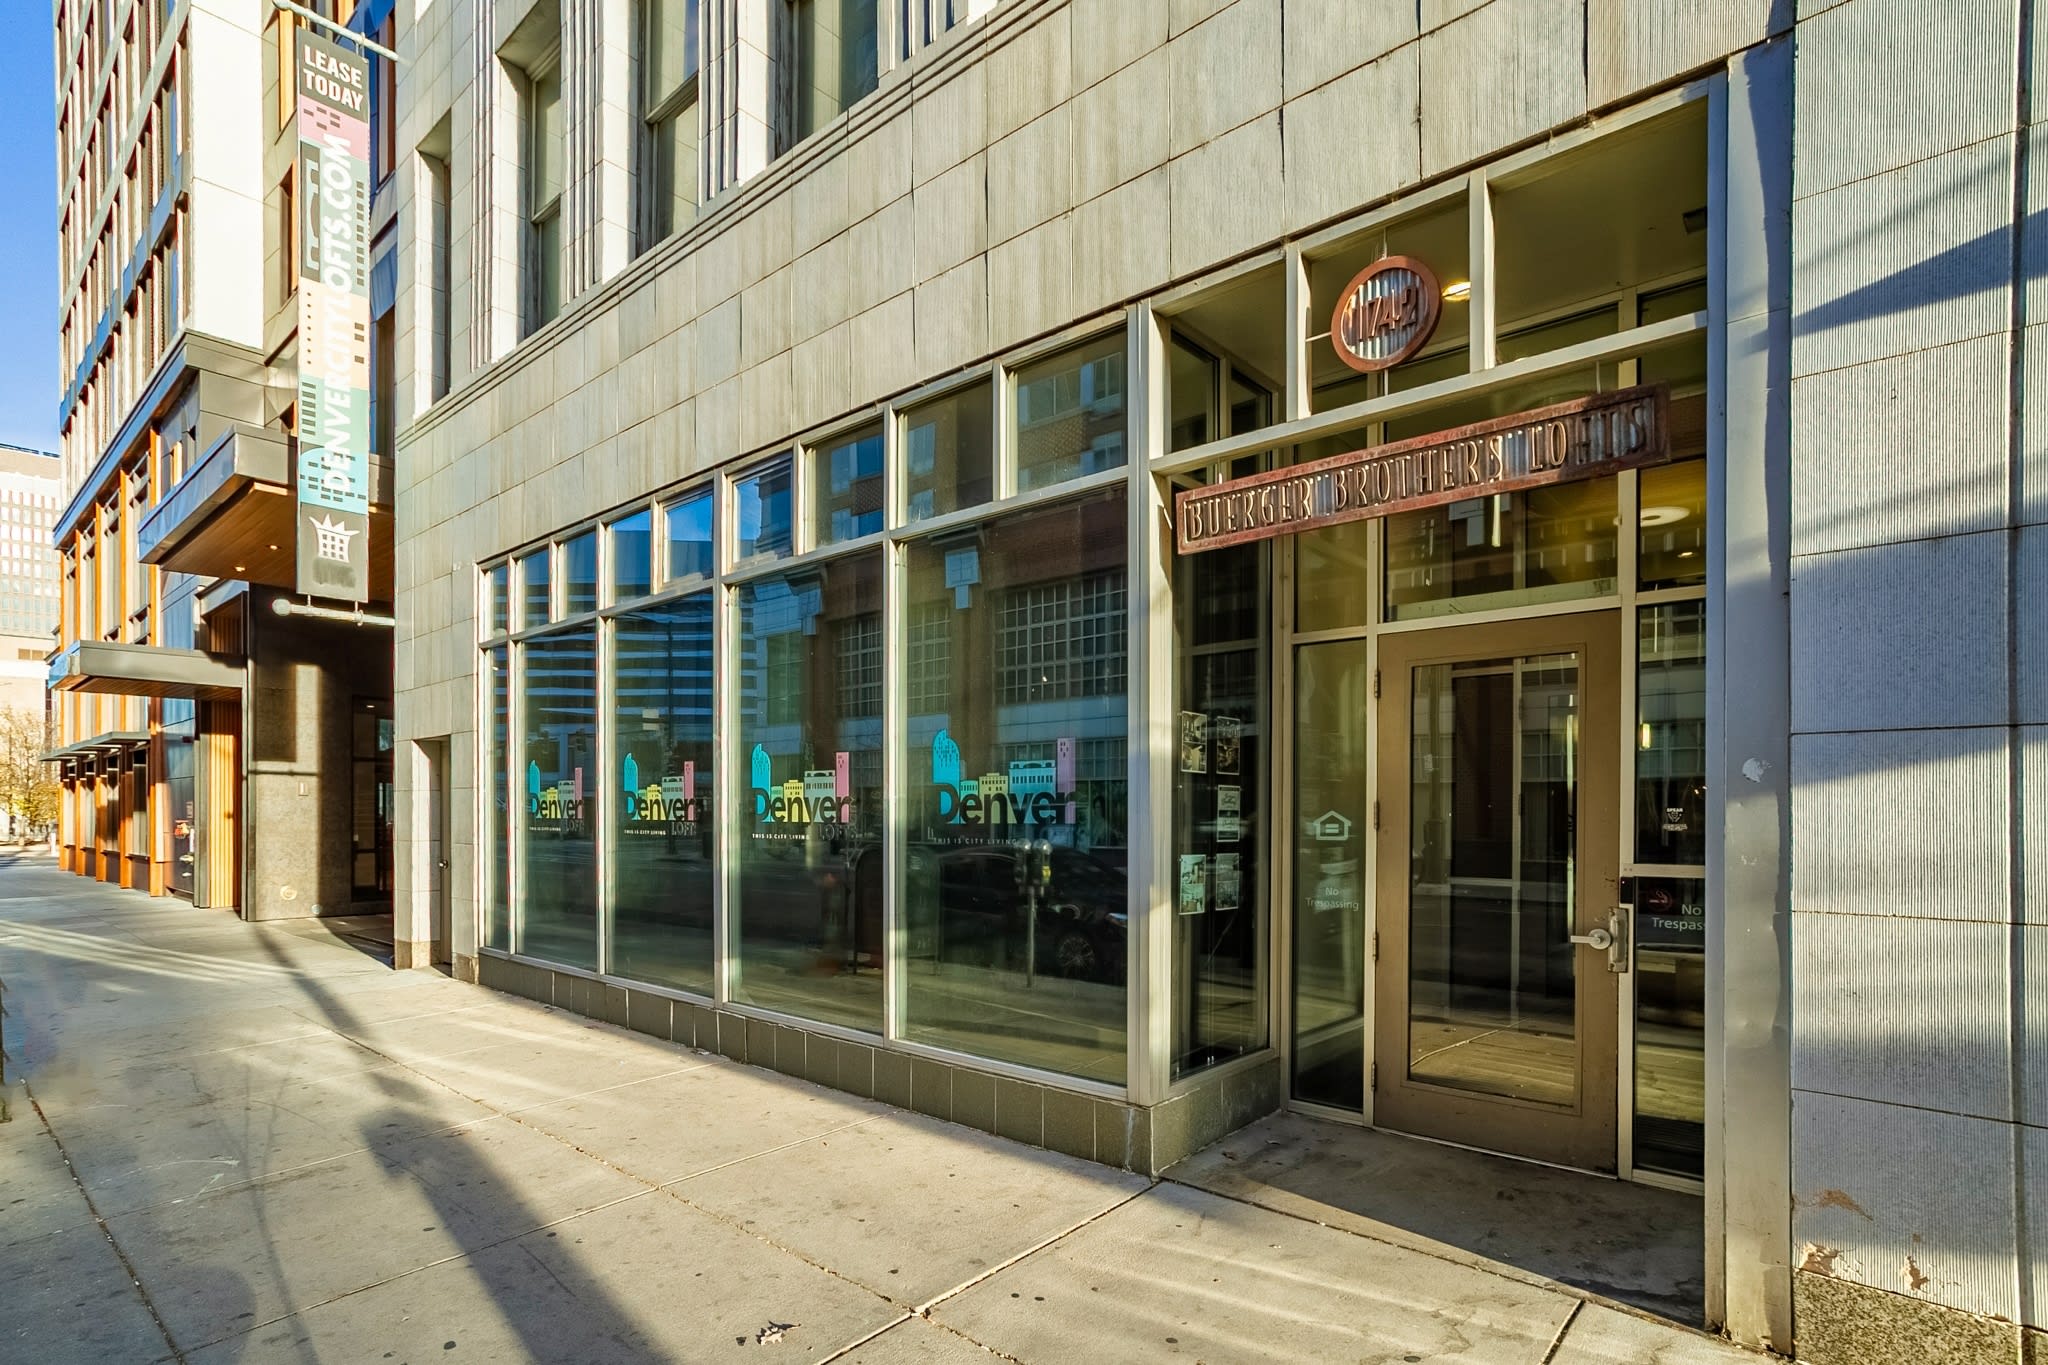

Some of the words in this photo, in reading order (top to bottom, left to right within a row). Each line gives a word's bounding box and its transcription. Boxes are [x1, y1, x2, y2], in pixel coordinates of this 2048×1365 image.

[304, 44, 363, 89] LEASE
[303, 68, 364, 112] TODAY
[321, 133, 352, 492] DENVERCITYLOFTS.COM
[1354, 285, 1418, 341] 1742
[1190, 477, 1312, 538] BUERGER
[1334, 435, 1503, 511] BROTHERS
[1529, 402, 1647, 471] LOFTS
[529, 793, 584, 819] Denver
[624, 789, 697, 821] Denver
[752, 787, 853, 824] Denver
[932, 783, 1080, 826] Denver
[987, 838, 1017, 846] LIVING
[1304, 897, 1359, 912] Trespassing
[1325, 887, 1340, 896] No
[1651, 916, 1704, 932] Trespas
[1681, 903, 1702, 915] No
